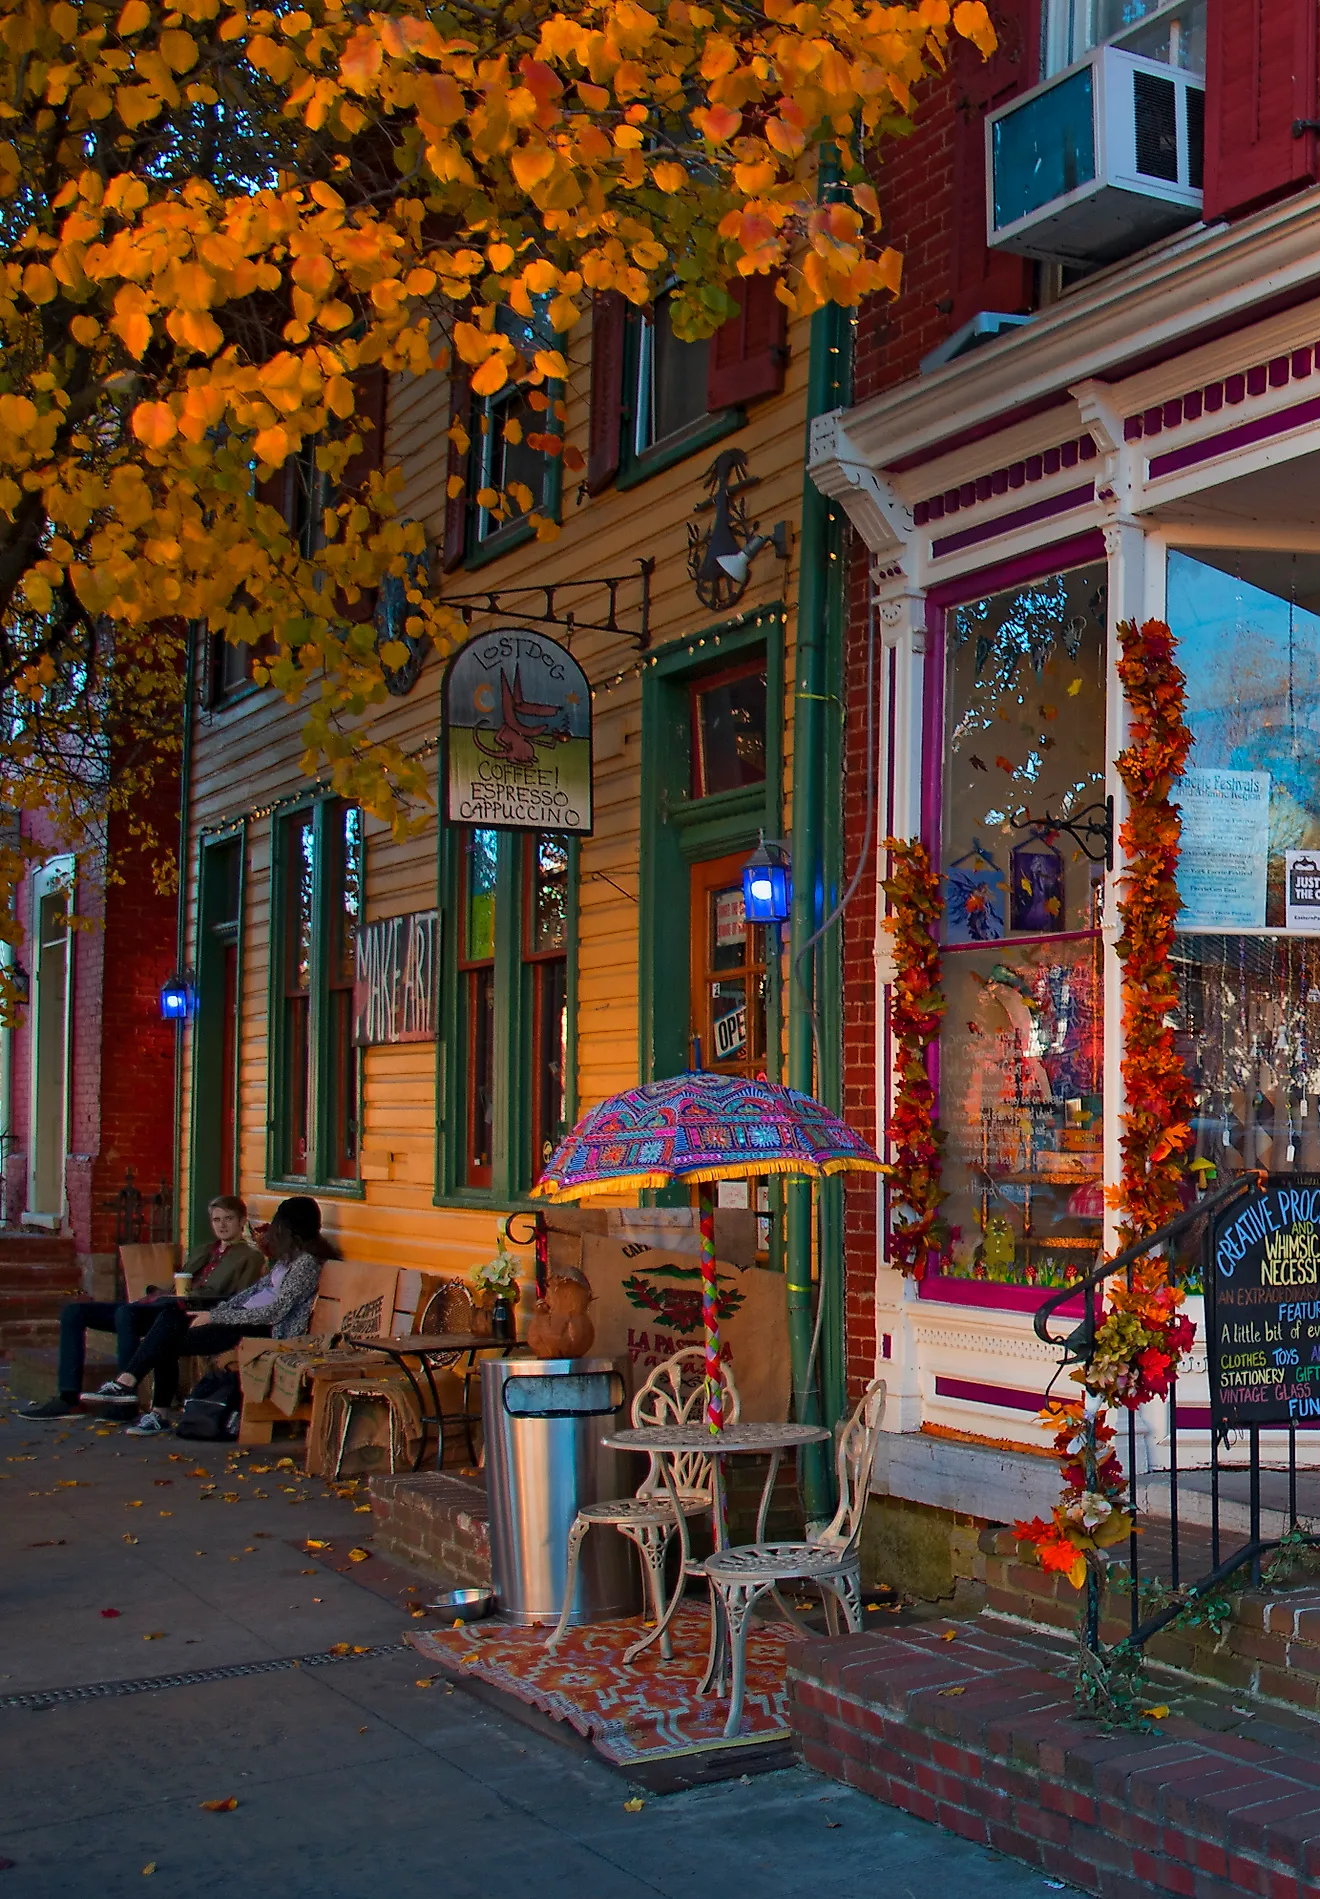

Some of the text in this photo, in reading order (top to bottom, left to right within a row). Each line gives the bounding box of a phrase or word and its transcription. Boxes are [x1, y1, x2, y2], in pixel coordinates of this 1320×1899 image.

[473, 637, 565, 681] LOST DOG
[478, 760, 560, 789] COFFEE!
[471, 782, 569, 807] ESPRESSO
[459, 798, 581, 827] CAPPUCCINO
[1295, 876, 1320, 888] JUST
[1295, 888, 1313, 900] THE
[355, 911, 439, 1042] MAKE ART
[718, 1008, 746, 1052] OPE
[1217, 1196, 1281, 1278] CREATIVE
[1291, 1221, 1314, 1236] AND
[628, 1329, 650, 1353] LA
[1220, 1322, 1231, 1344] A
[1233, 1320, 1262, 1343] little
[1265, 1323, 1283, 1342] bit
[1290, 1320, 1302, 1340] of
[1220, 1351, 1267, 1370] CLOTHES
[1271, 1347, 1300, 1366] TOYS
[1220, 1367, 1285, 1388] STATIONERY
[1219, 1385, 1269, 1404] VINTAGE
[1274, 1382, 1312, 1401] GLASS
